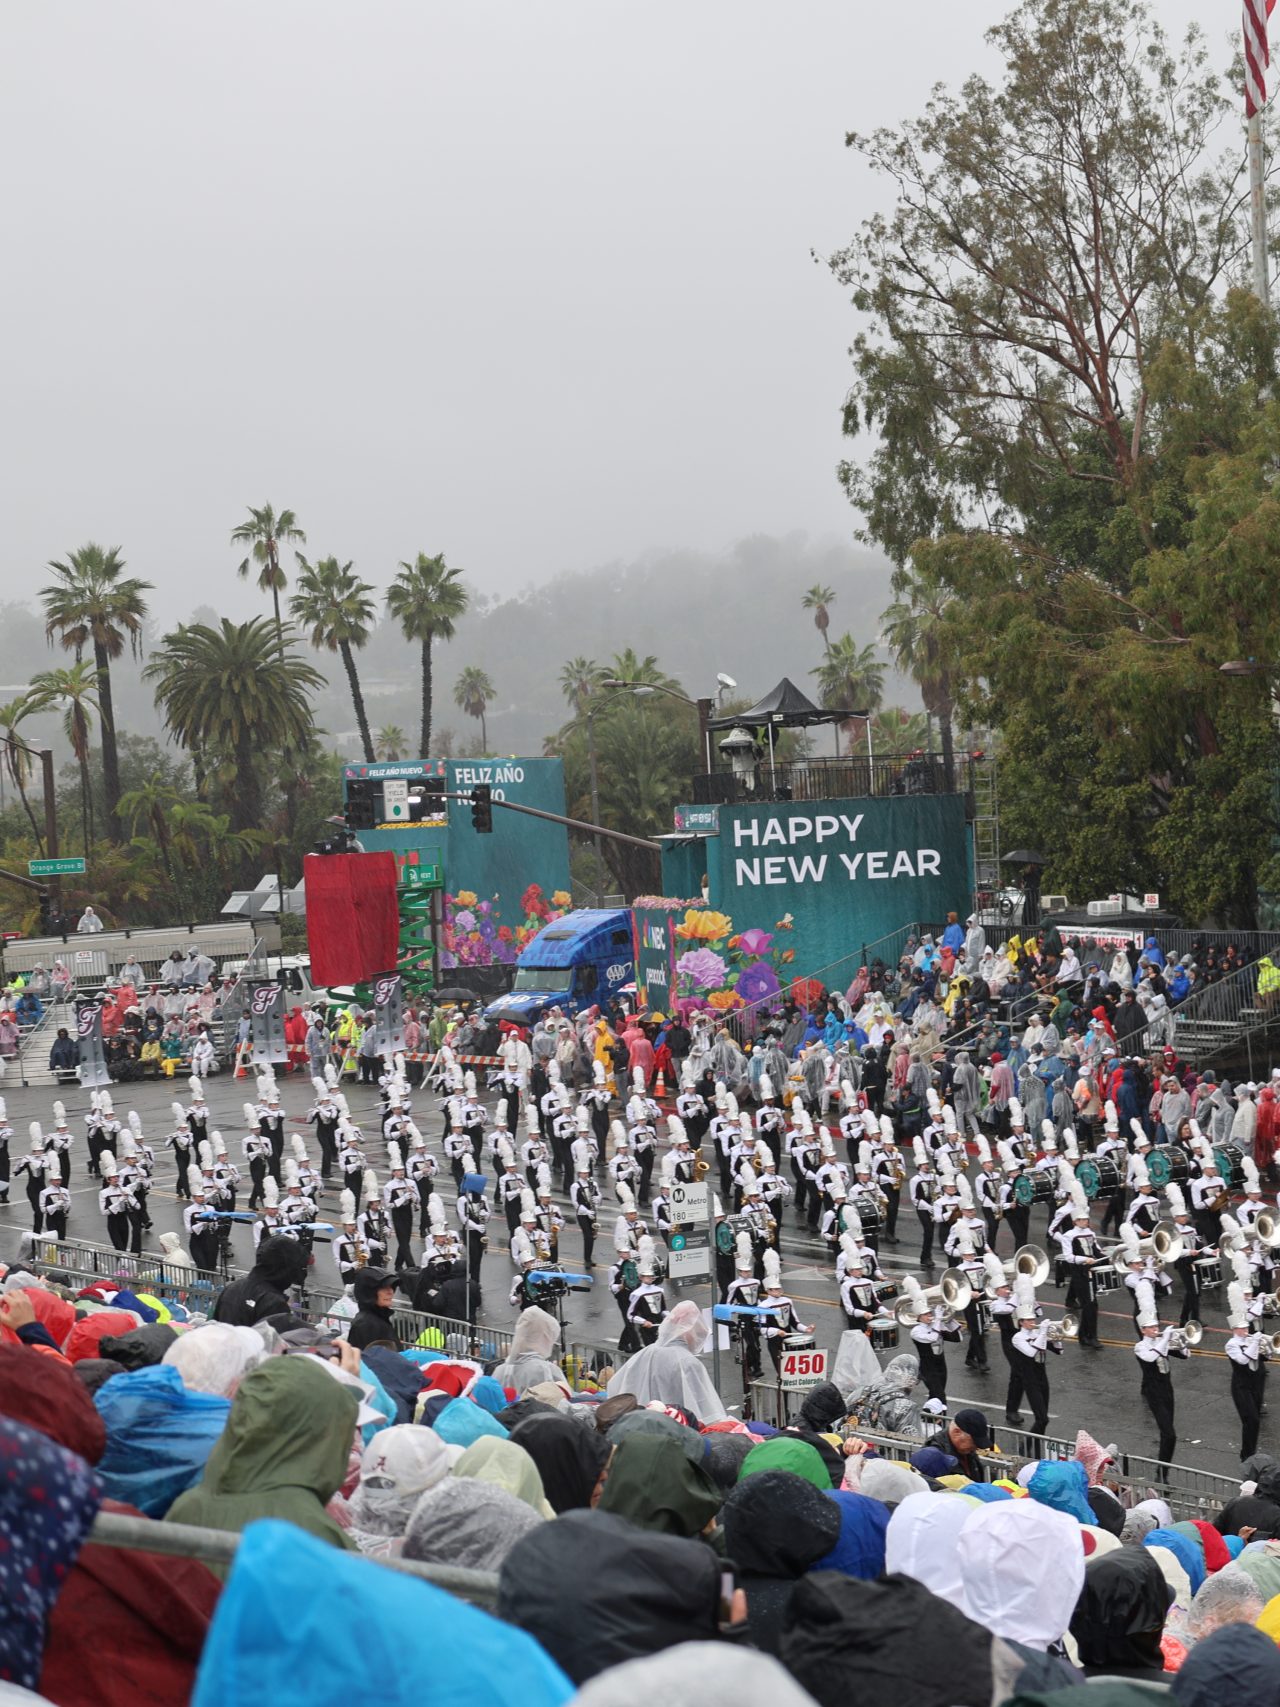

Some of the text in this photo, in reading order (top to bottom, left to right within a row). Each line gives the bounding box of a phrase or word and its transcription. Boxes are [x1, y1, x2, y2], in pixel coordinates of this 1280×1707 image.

[369, 768, 385, 777] FELIZ
[400, 766, 423, 775] NUEVO
[455, 763, 524, 784] FELIZ AÑO
[456, 788, 505, 806] NUO
[733, 814, 864, 847] HAPPY
[735, 849, 941, 886] NEW YEAR
[651, 926, 666, 951] NBC
[687, 1197, 707, 1205] Metro
[672, 1211, 686, 1221] 180
[784, 1354, 824, 1375] 450
[783, 1379, 798, 1387] West
